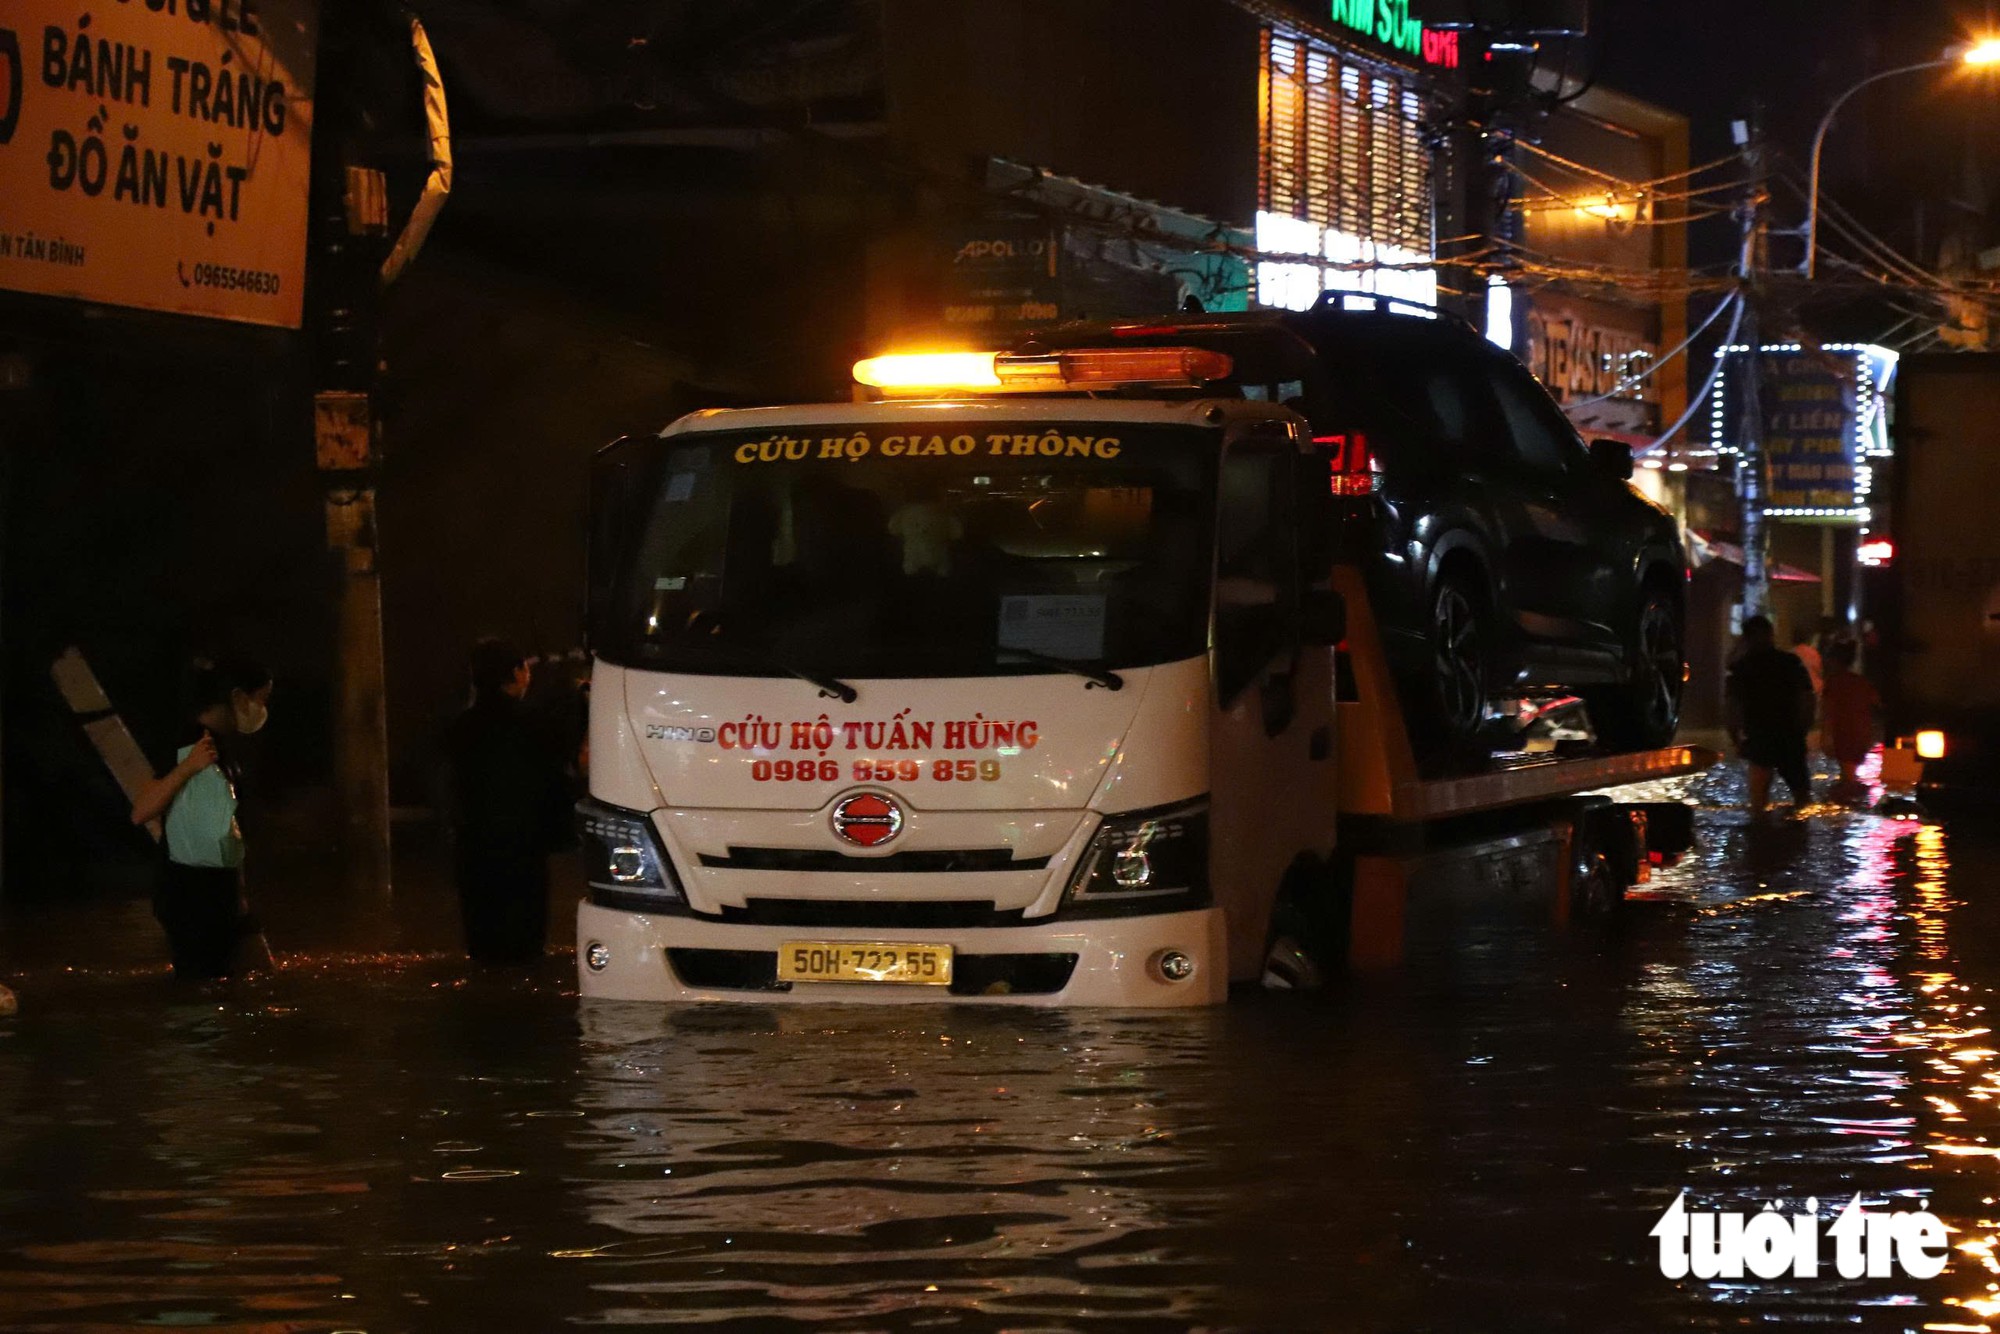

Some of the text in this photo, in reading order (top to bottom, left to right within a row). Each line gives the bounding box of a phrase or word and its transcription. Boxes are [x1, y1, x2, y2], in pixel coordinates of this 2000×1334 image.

[42, 12, 285, 137] BÁNH TRÁNG
[47, 104, 248, 236] ĐỒ ĂN VẶT
[16, 230, 46, 262] TÂN
[49, 236, 85, 267] BÌNH
[194, 263, 280, 295] 0965546630
[735, 429, 1121, 464] CỨU HỘ GIAO THÔNG
[646, 724, 716, 743] HINO
[717, 707, 1039, 757] CỨU HỘ TUẤN HÙNG
[752, 759, 1001, 782] 0986 859 859
